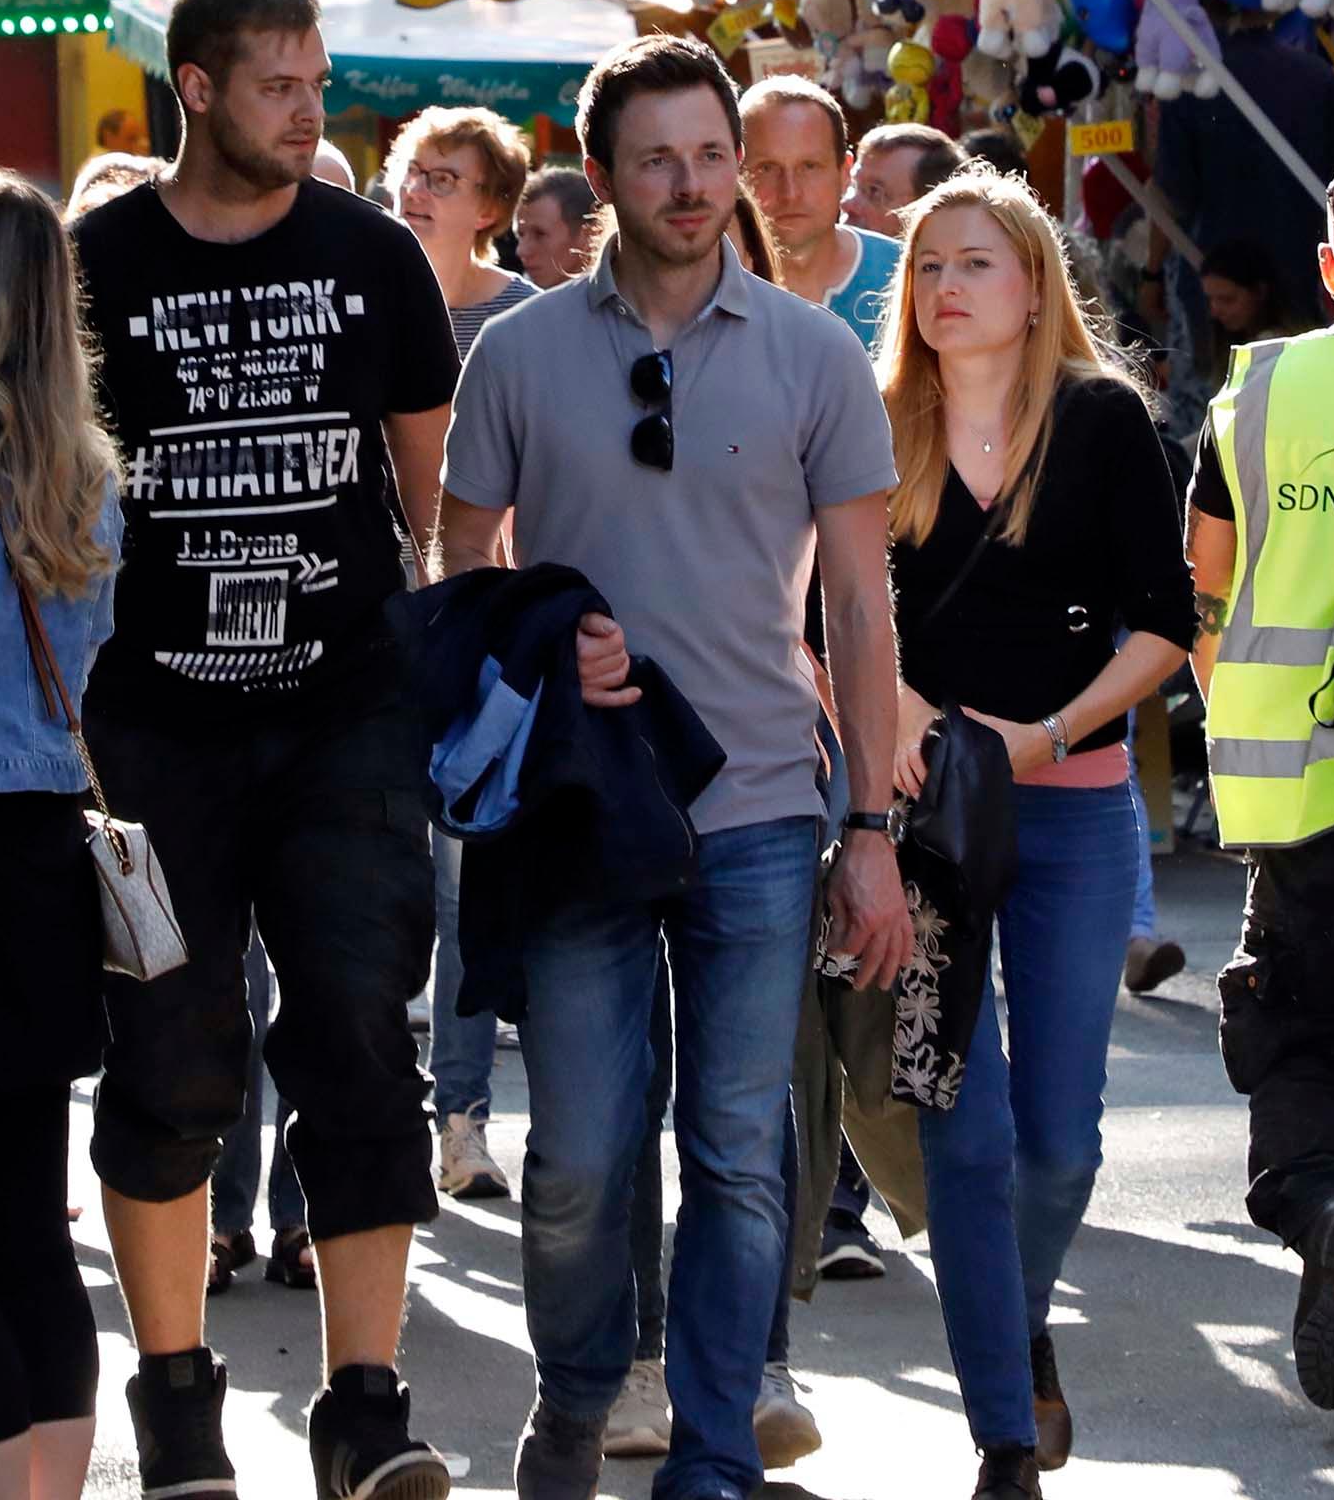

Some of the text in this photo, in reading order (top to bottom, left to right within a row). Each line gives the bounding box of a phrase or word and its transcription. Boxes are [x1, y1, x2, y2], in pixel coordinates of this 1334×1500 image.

[151, 279, 344, 352] NEW YORK
[311, 342, 325, 370] N
